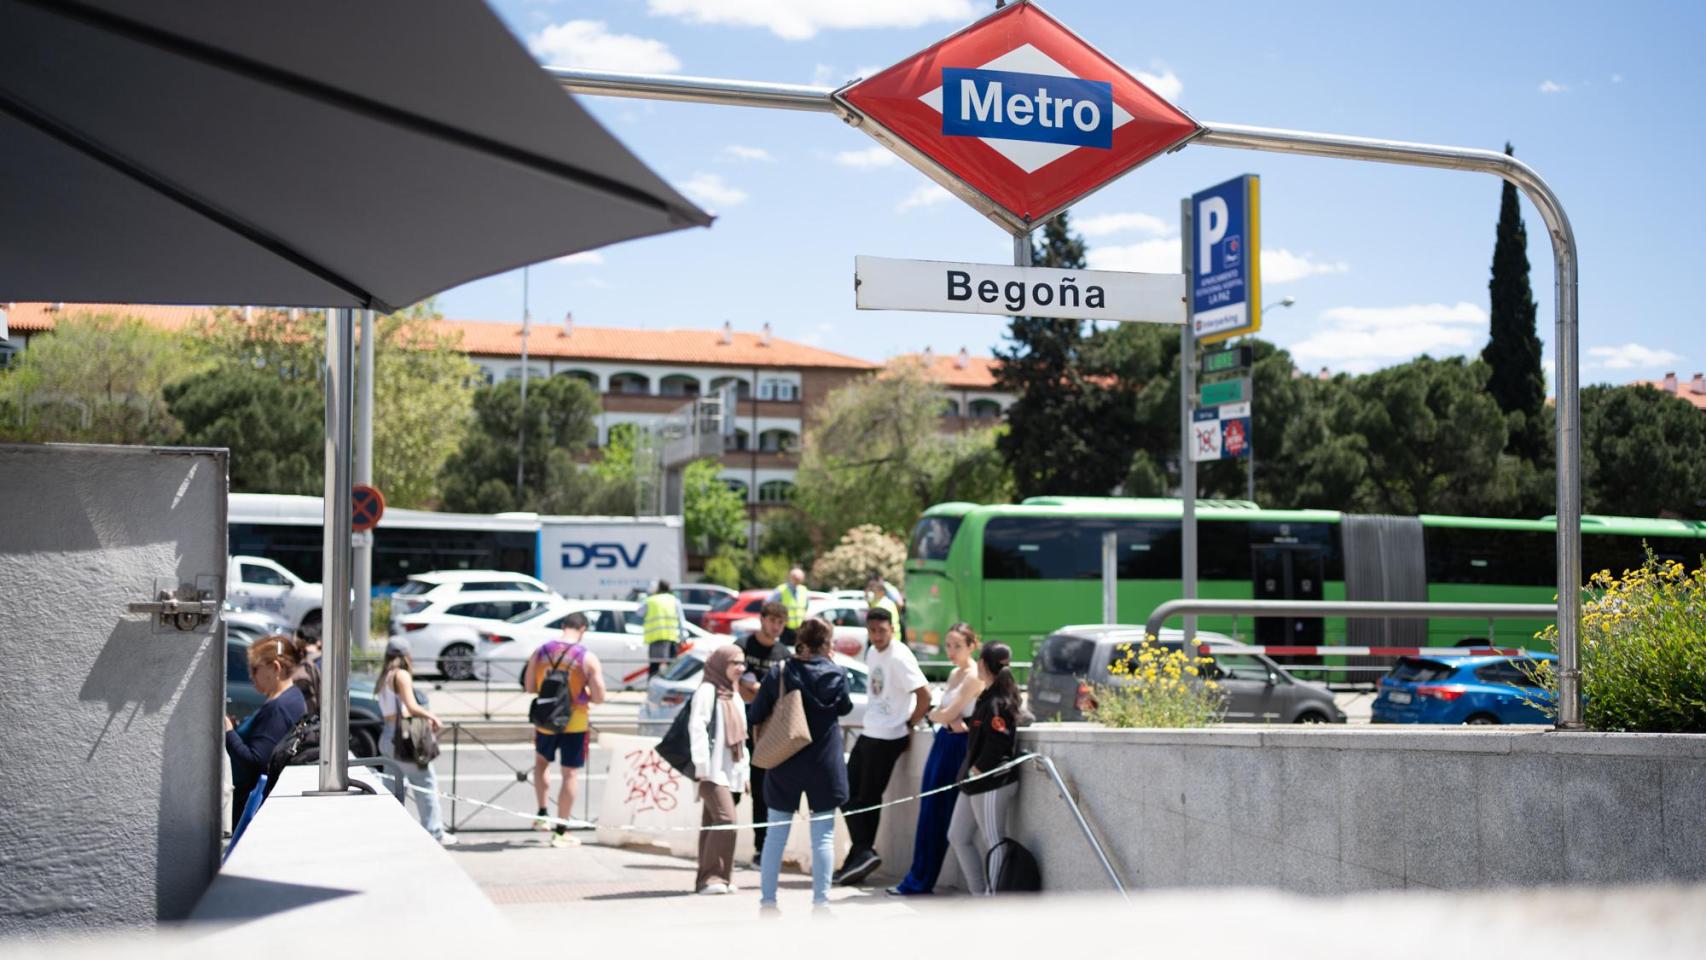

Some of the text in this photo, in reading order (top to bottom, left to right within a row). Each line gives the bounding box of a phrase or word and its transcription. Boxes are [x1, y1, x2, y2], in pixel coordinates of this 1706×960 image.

[960, 79, 1100, 132] Metro
[1199, 195, 1228, 275] P
[946, 270, 1105, 312] Begoña
[1208, 289, 1230, 305] LA PAZ
[561, 543, 648, 569] DSV
